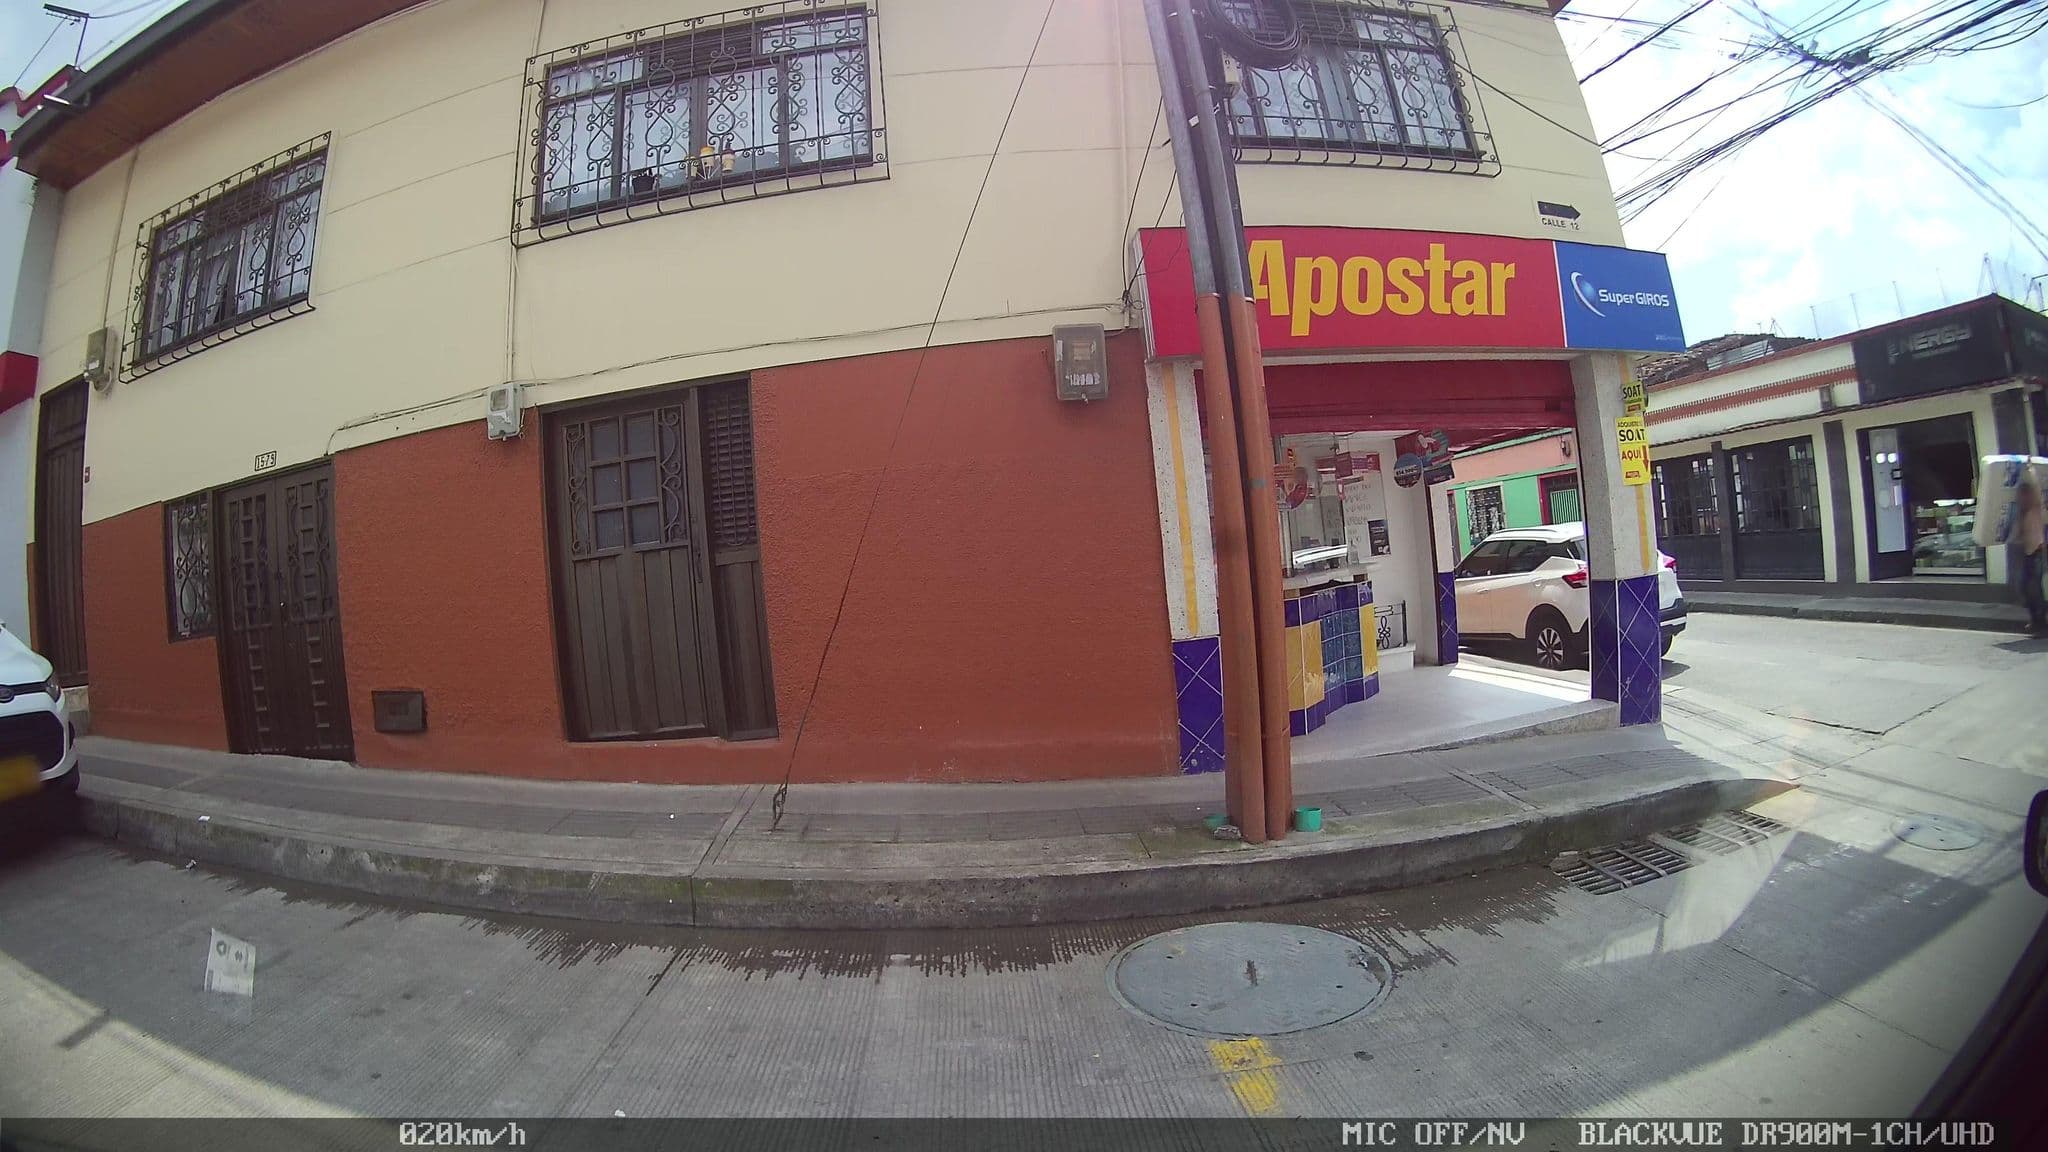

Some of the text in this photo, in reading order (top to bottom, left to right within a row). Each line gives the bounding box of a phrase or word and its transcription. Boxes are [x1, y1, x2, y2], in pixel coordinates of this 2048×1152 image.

[1541, 217, 1580, 230] CALLE 12
[1247, 239, 1515, 337] Apostar
[1623, 385, 1641, 399] SOAT
[1619, 429, 1645, 441] SOAT
